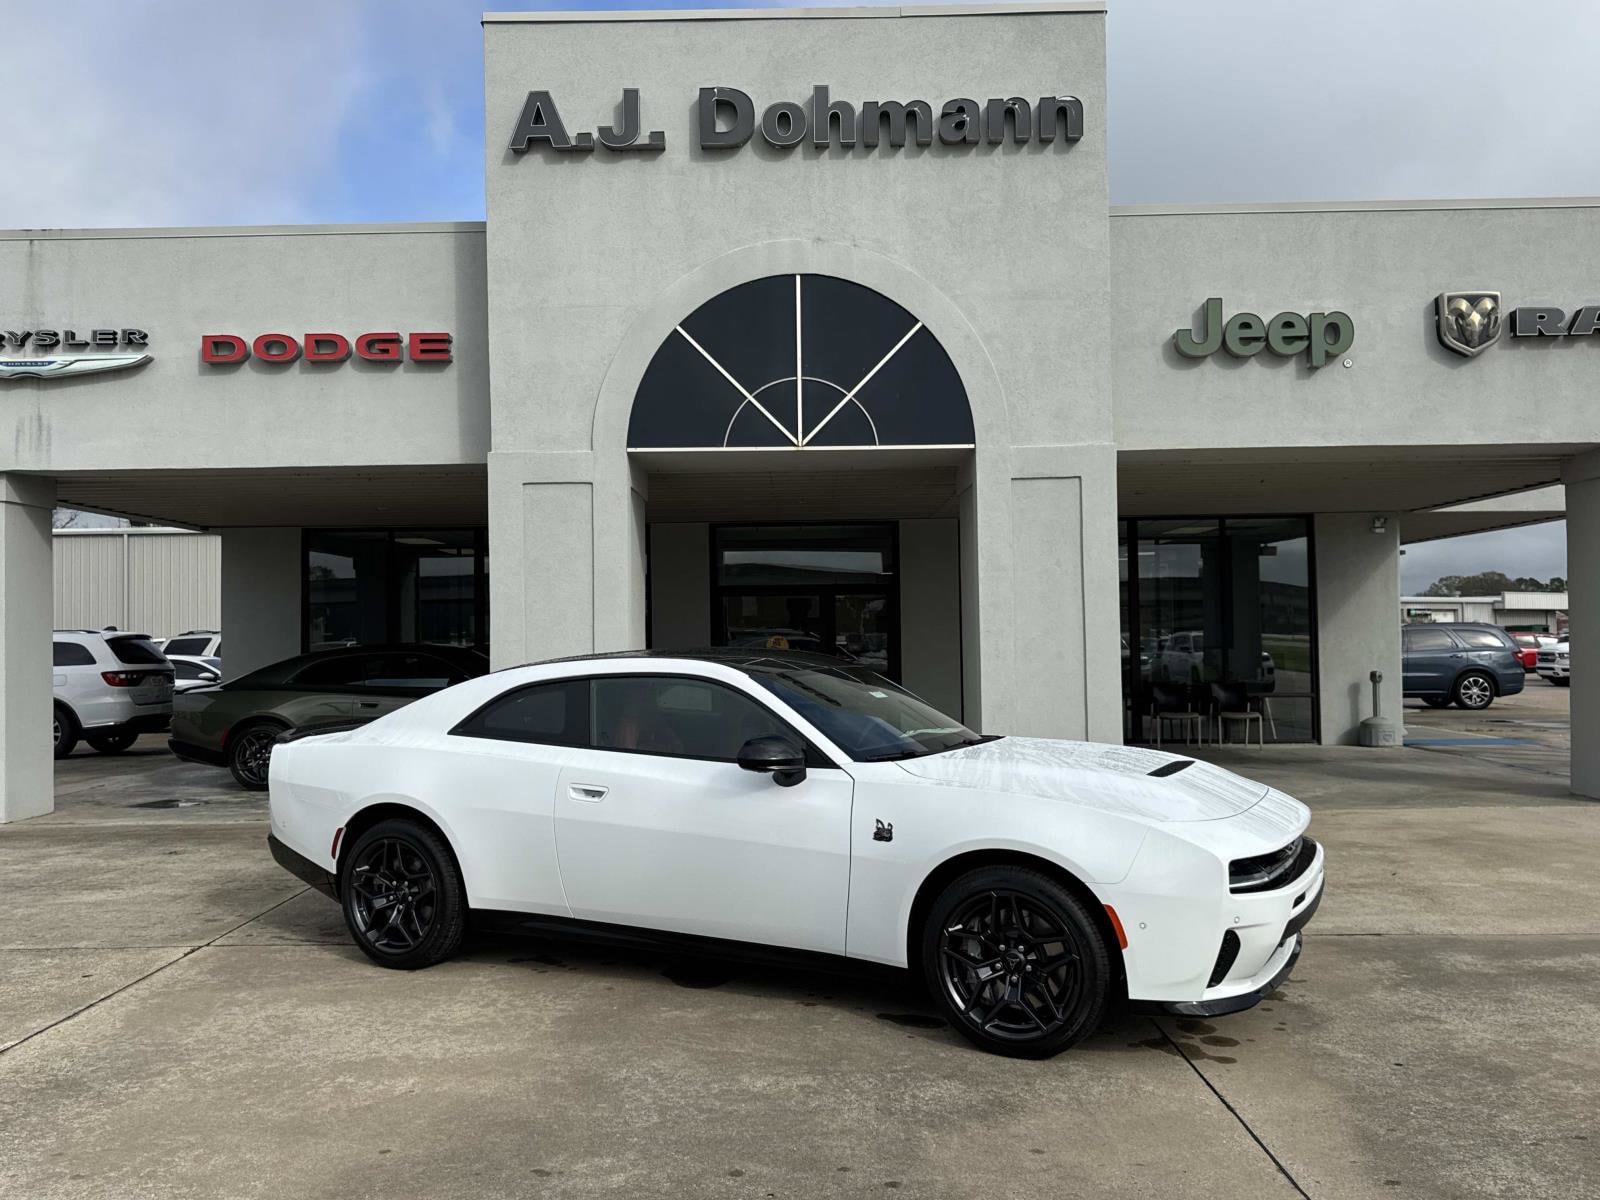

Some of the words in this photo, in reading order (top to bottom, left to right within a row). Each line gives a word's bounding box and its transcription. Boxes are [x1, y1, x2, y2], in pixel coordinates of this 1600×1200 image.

[508, 88, 666, 151] A.J.
[698, 84, 1085, 151] Dohmann
[0, 328, 149, 346] YSLER
[201, 332, 453, 364] DODGE
[1174, 297, 1355, 369] Jeep
